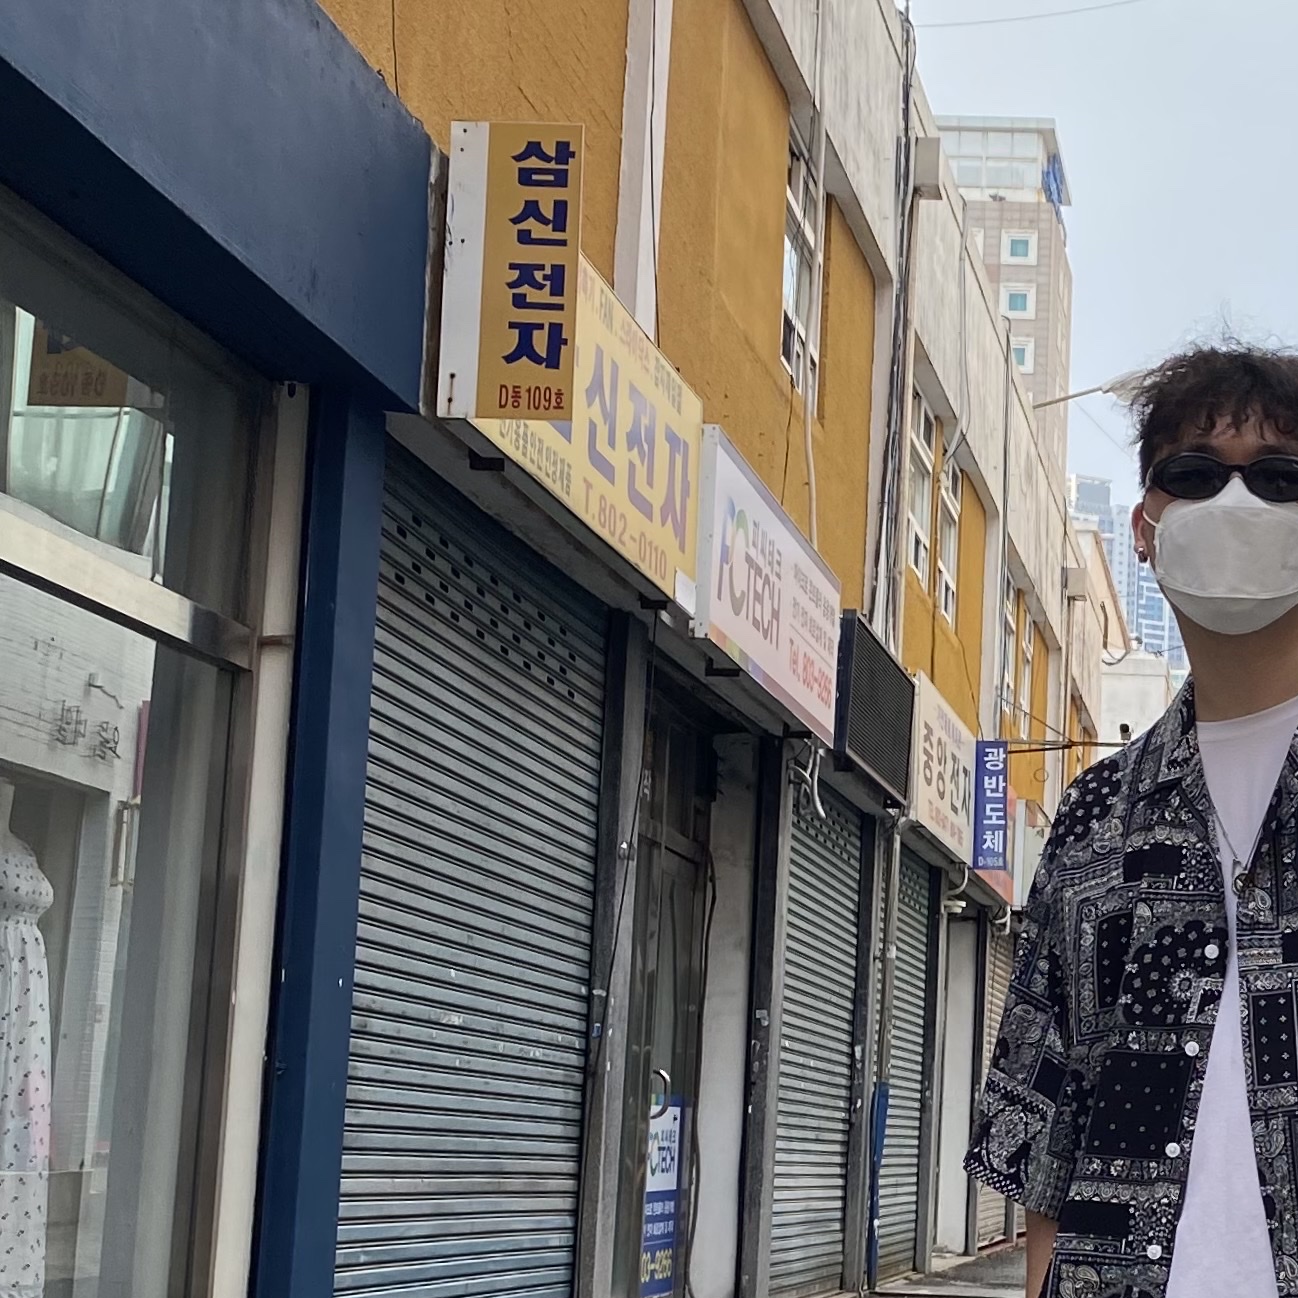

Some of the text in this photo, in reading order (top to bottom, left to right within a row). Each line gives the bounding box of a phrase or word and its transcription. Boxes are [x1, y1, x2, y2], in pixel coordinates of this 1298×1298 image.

[502, 140, 576, 370] 삼신전자
[499, 384, 565, 411] D동 109호
[575, 342, 691, 554] 신전자
[923, 720, 972, 827] 중앙전자
[982, 747, 1006, 853] 광반도체
